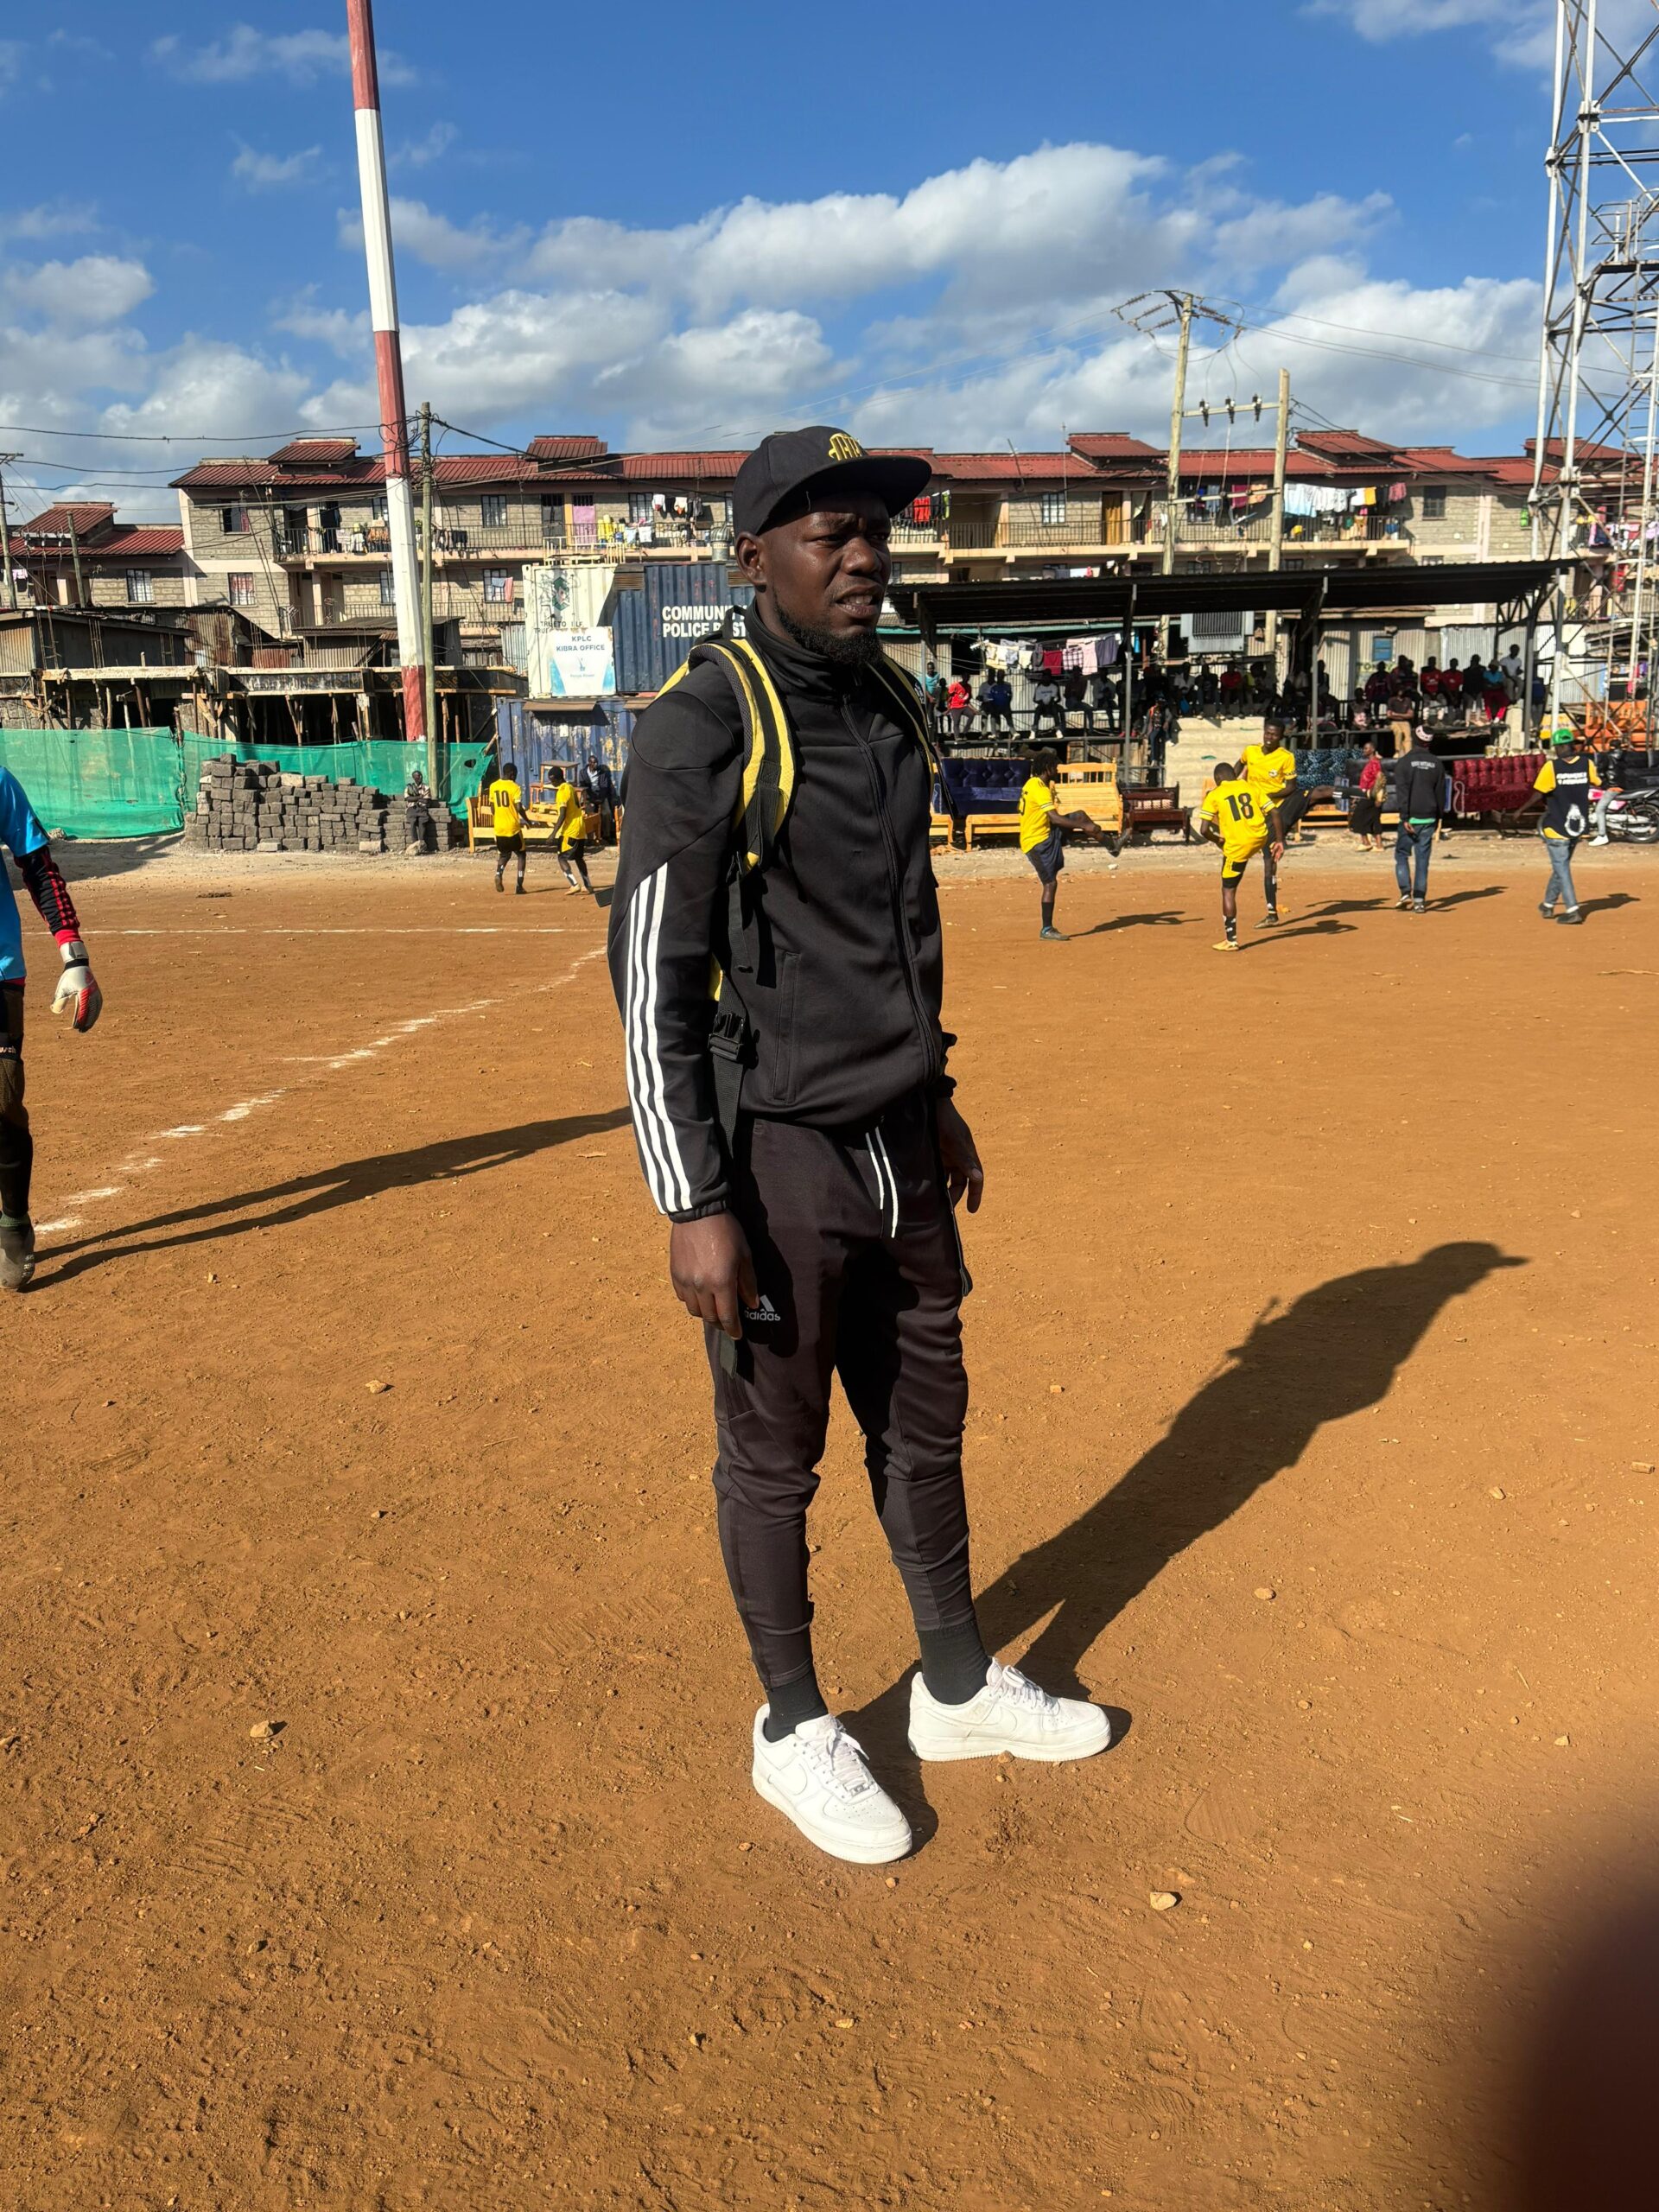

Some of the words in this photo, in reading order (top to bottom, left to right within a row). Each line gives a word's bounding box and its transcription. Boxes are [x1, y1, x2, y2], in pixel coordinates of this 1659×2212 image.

[662, 621, 709, 638] POLICE
[713, 621, 747, 638] PST
[494, 790, 510, 807] 10
[1224, 791, 1255, 822] 18
[744, 1308, 781, 1322] adidas
